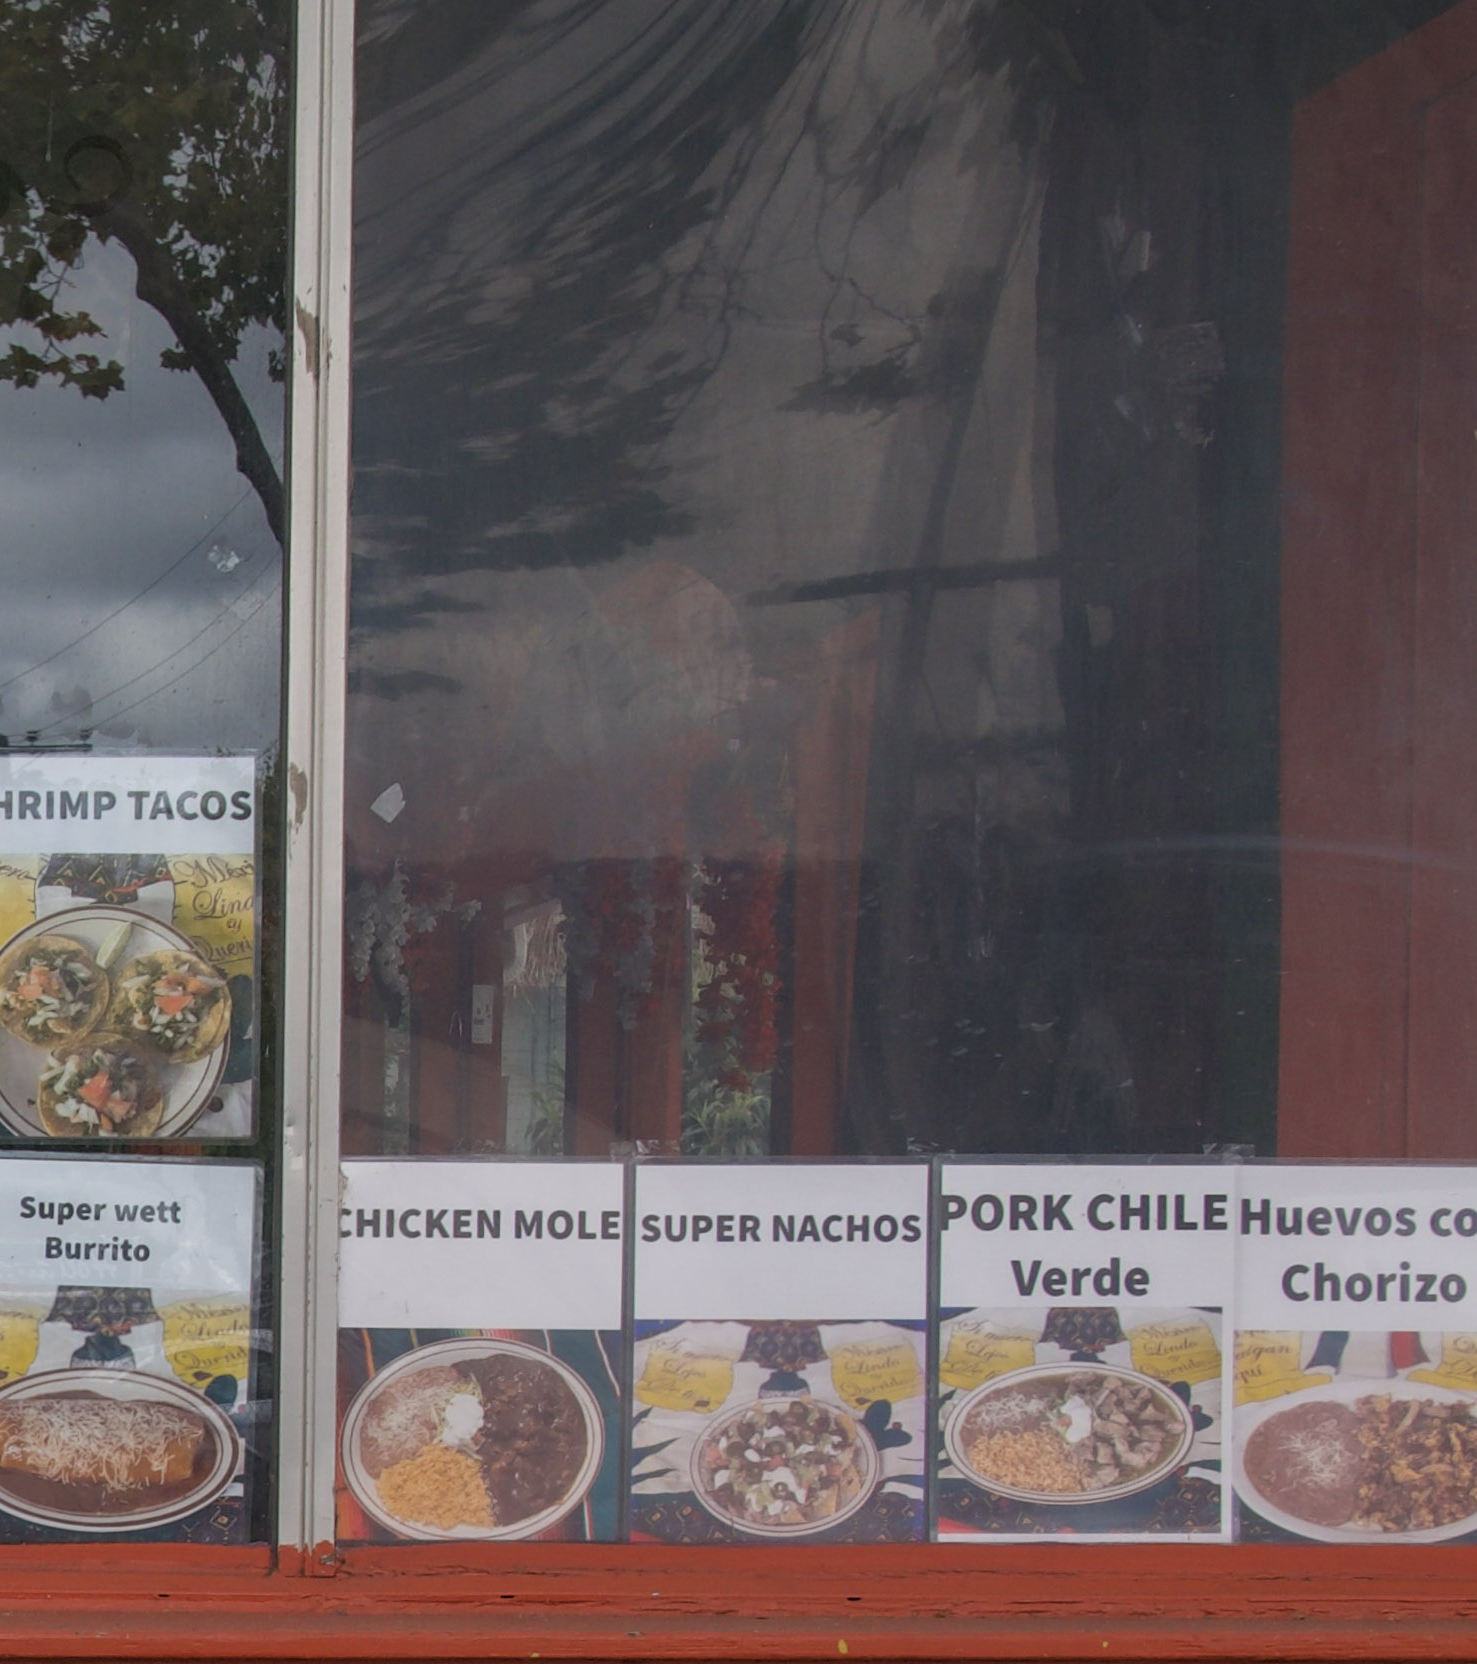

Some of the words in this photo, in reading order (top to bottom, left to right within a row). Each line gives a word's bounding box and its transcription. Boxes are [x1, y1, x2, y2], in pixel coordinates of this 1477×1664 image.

[128, 789, 253, 821] TACOS
[19, 1195, 107, 1226] Super
[115, 1199, 182, 1225] wett
[339, 1207, 502, 1240] CHICKEN
[514, 1208, 621, 1241] MOLE
[941, 1193, 1074, 1232] PORK
[1086, 1193, 1229, 1233] CHILE
[1240, 1198, 1417, 1238] Huevos
[640, 1213, 762, 1243] SUPER
[772, 1213, 922, 1244] NACHOS
[44, 1234, 152, 1264] Burrito
[1010, 1257, 1150, 1297] Verde
[1281, 1262, 1467, 1303] Chorizo
